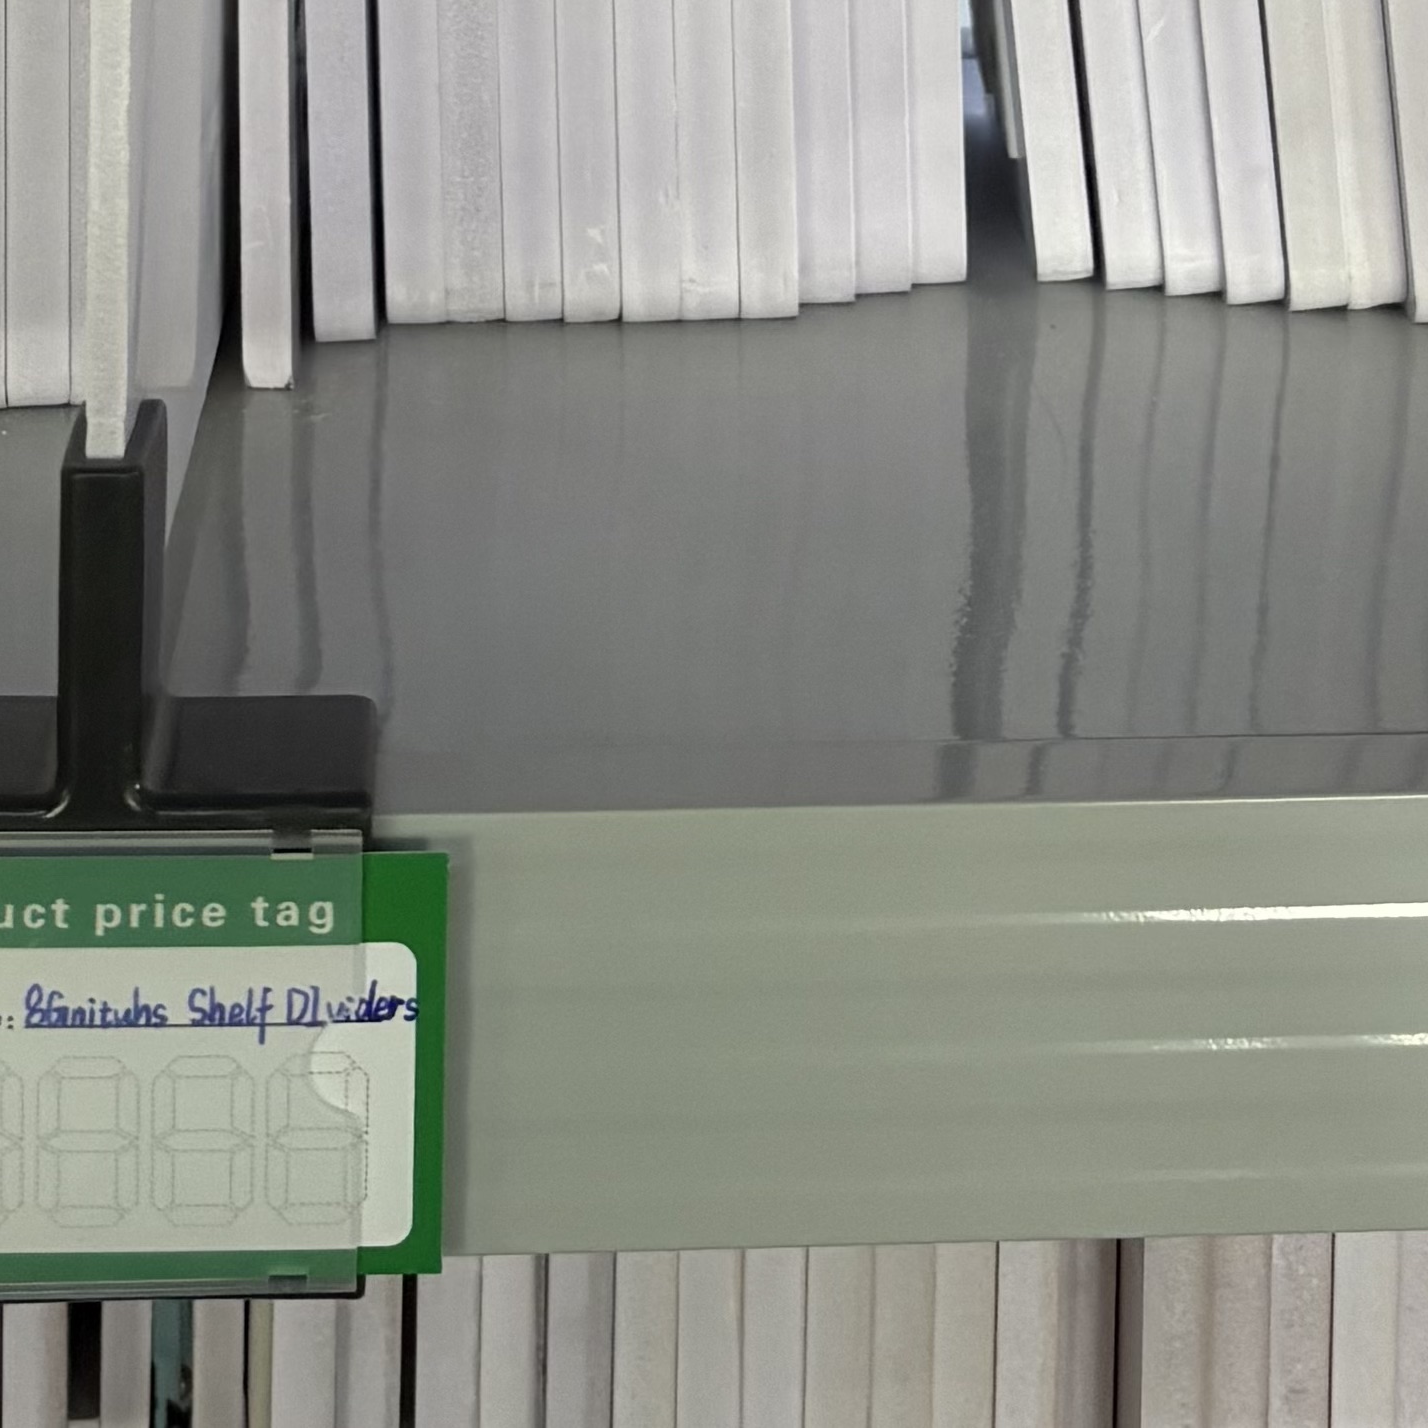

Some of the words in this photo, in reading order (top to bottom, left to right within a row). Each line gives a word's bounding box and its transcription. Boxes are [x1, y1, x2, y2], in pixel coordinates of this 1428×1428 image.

[94, 892, 227, 935] price
[250, 894, 336, 934] tag
[187, 985, 274, 1046] Shelf
